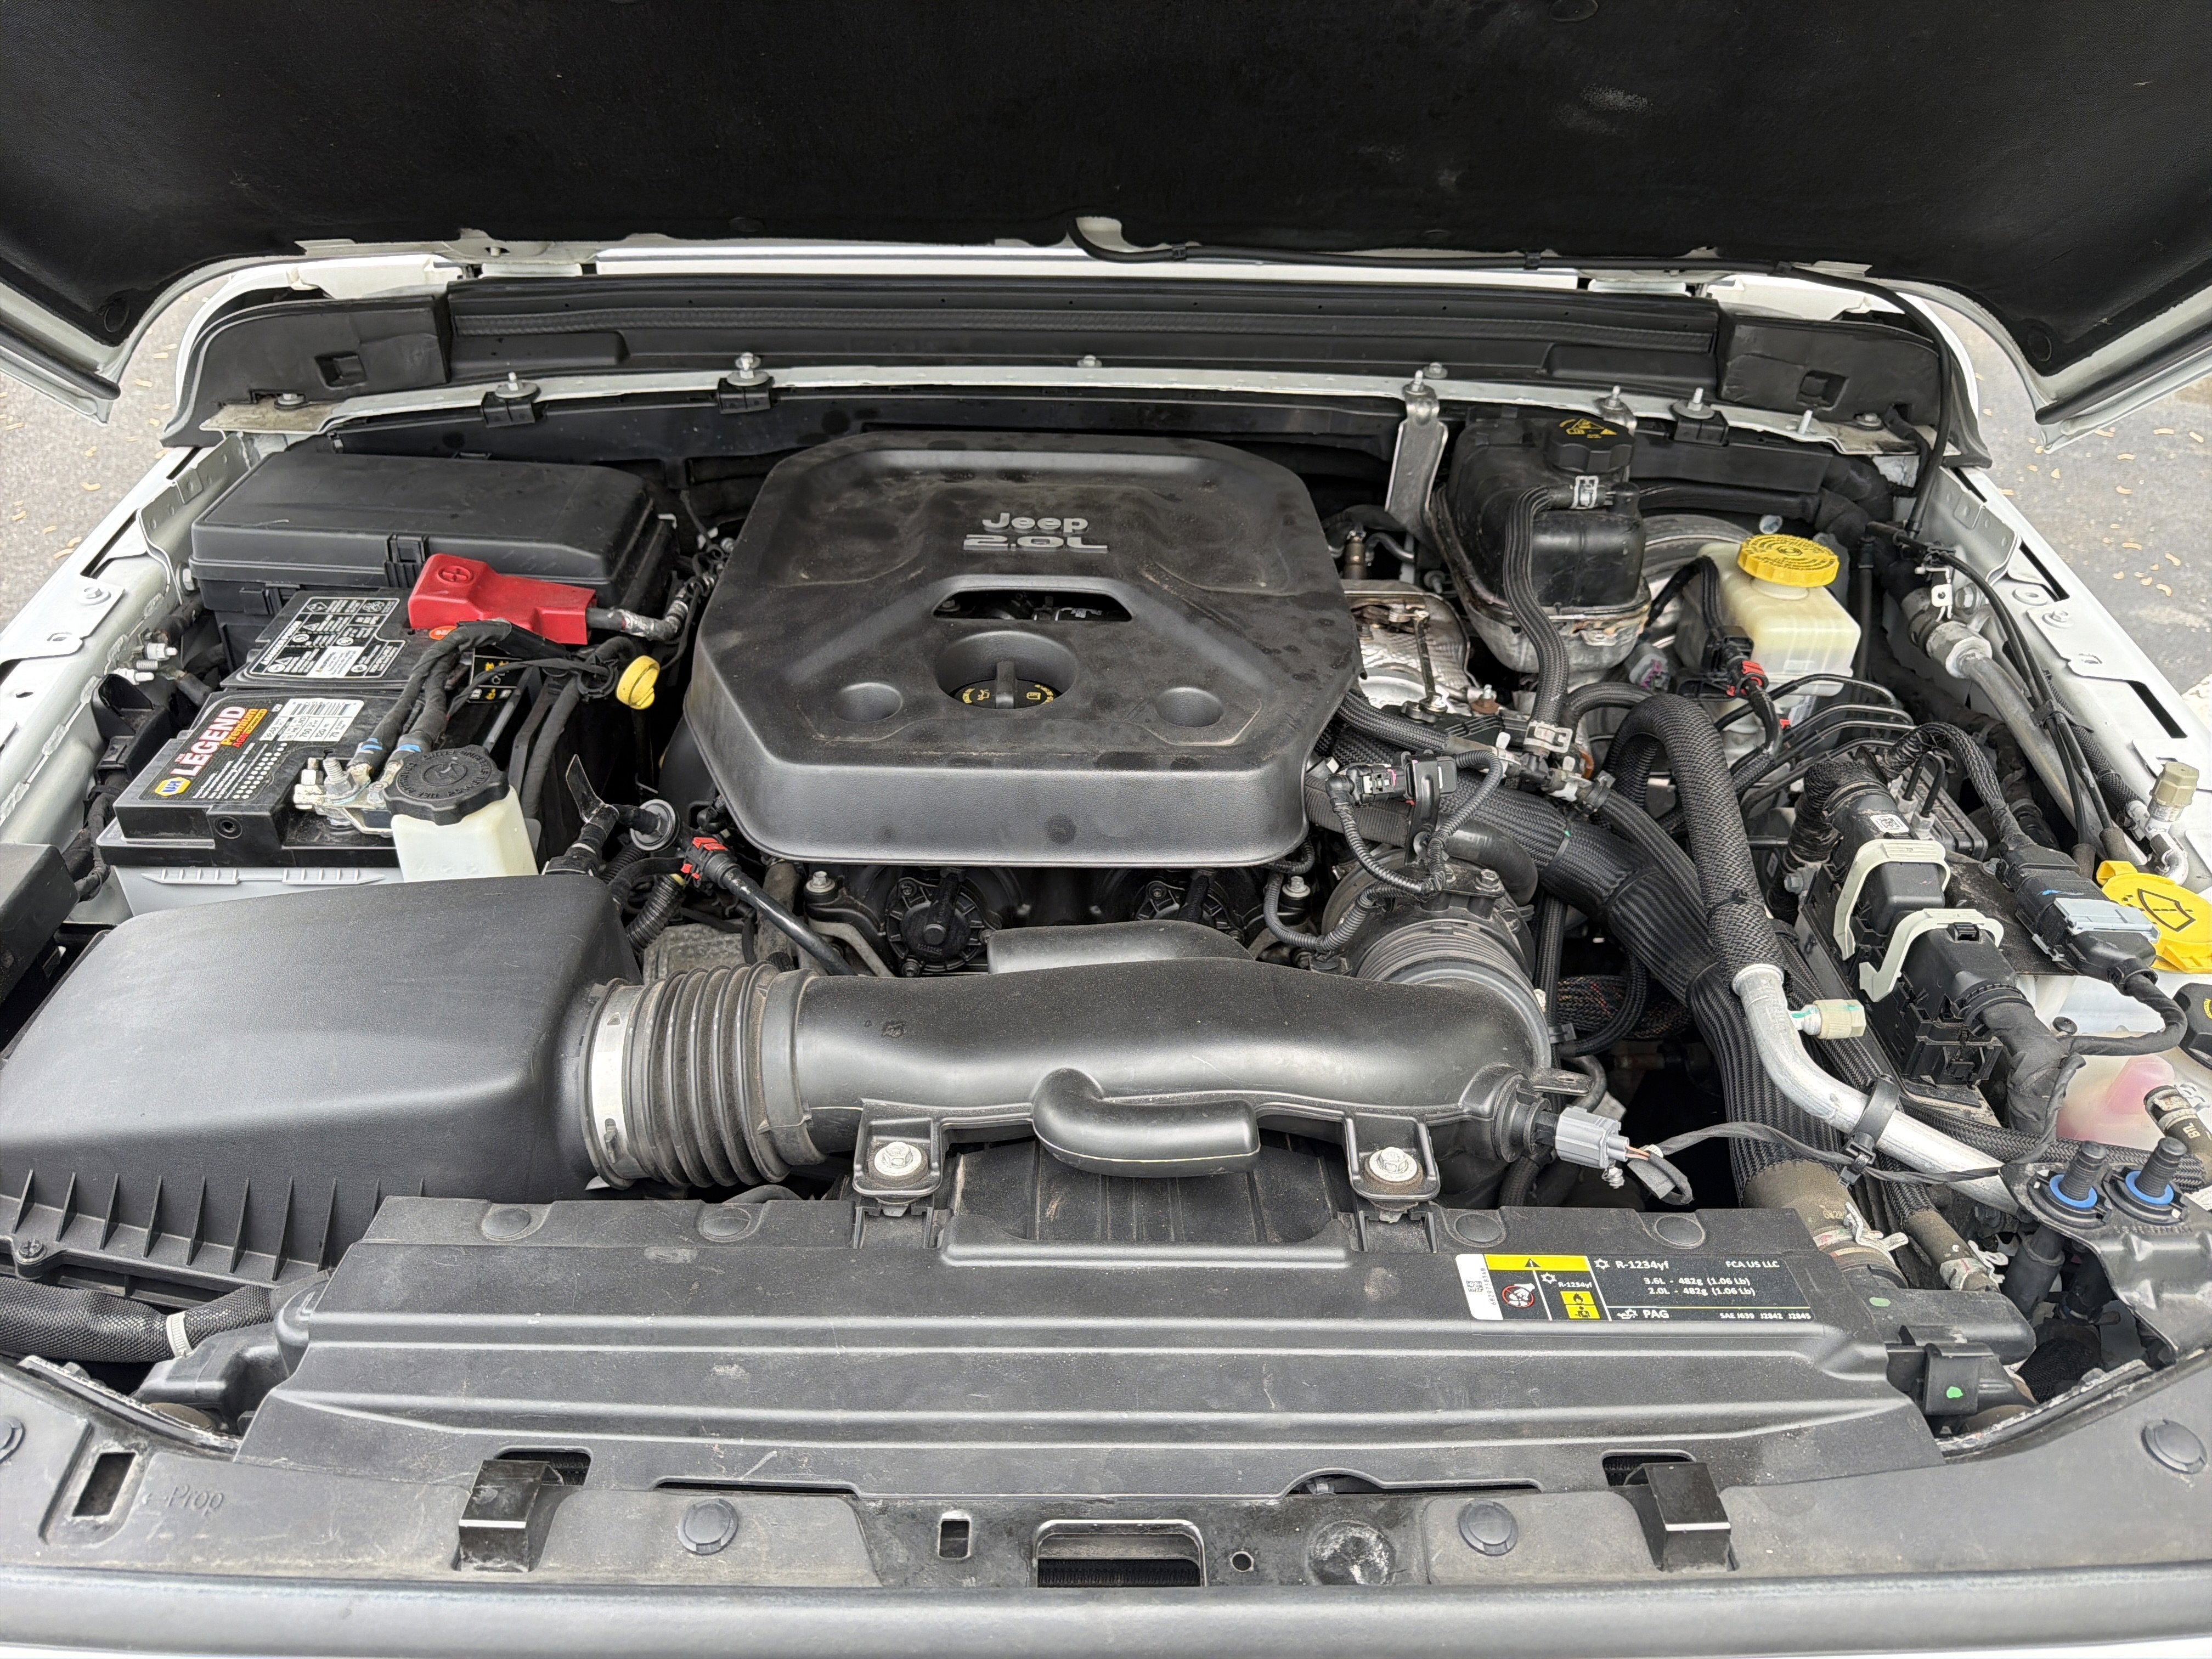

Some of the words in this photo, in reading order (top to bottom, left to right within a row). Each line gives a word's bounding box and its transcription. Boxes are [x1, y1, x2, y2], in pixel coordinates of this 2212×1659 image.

[982, 512, 1088, 535] Jeep
[963, 534, 1109, 553] 2.0L
[221, 708, 259, 746] Premium
[170, 706, 247, 777] LEGEND
[174, 753, 185, 763] THE
[161, 780, 184, 793] NAPA
[1615, 1260, 1669, 1271] R-1234yf
[1679, 1277, 1703, 1285] 482g
[1707, 1277, 1733, 1285] (1.06
[1734, 1277, 1751, 1286] Lb)
[1683, 1288, 1708, 1296] 482g
[1712, 1287, 1738, 1296] (1.06
[1739, 1288, 1756, 1296] Lb)
[1643, 1310, 1669, 1318] PAG
[166, 1483, 224, 1517] Prop
